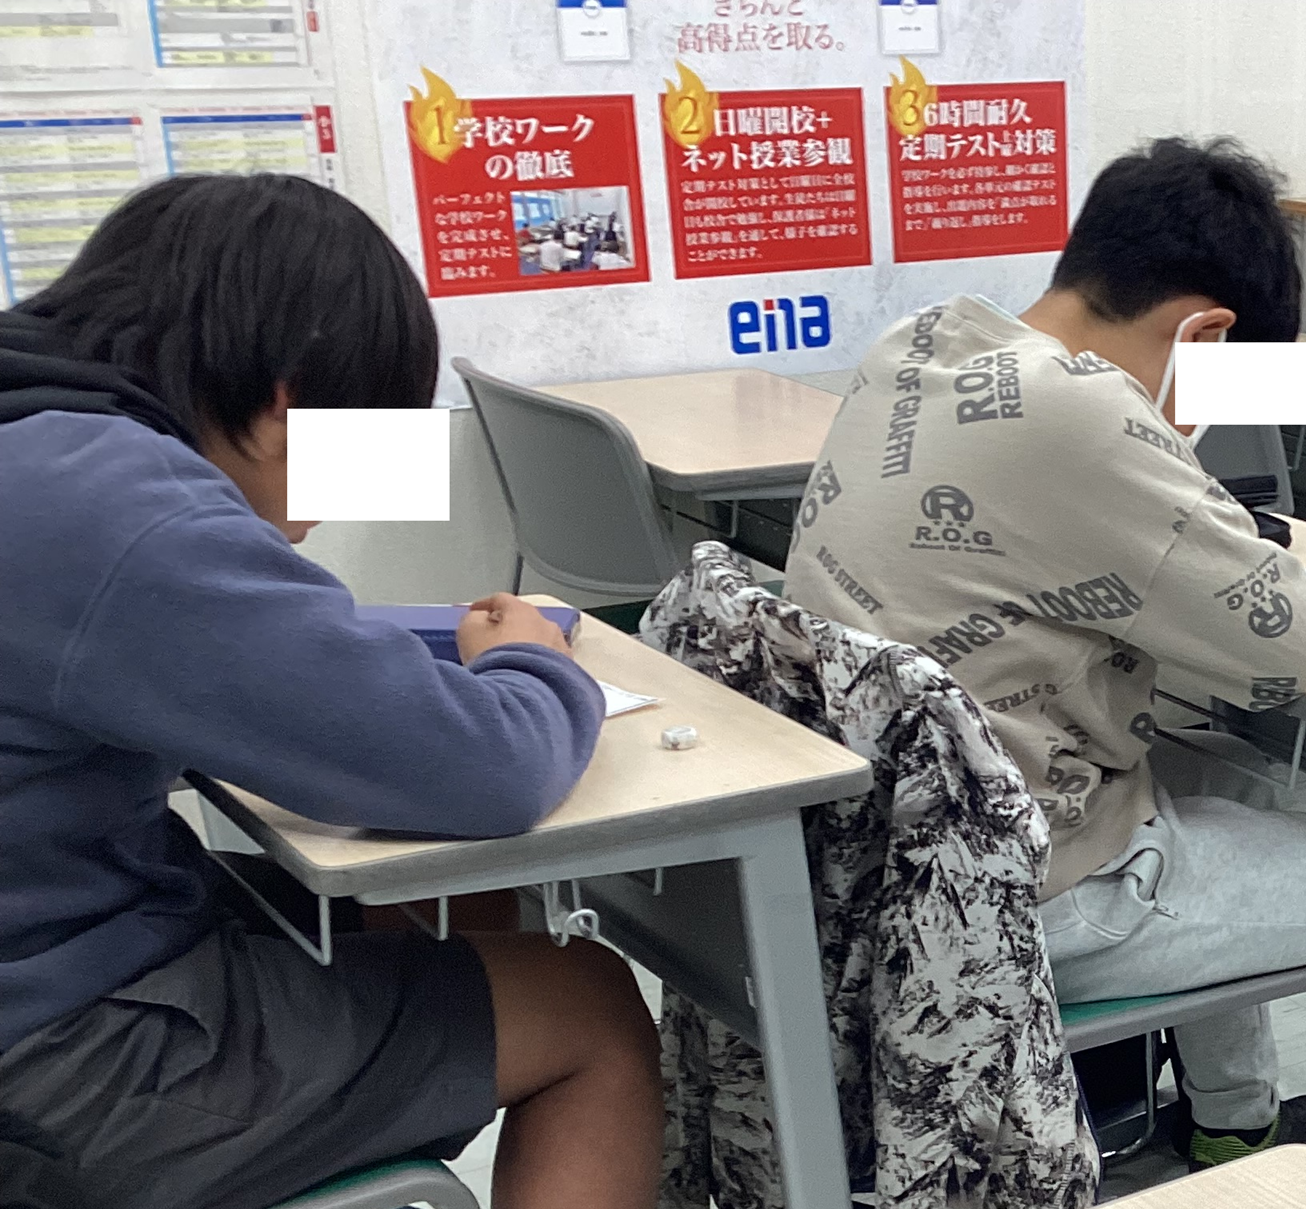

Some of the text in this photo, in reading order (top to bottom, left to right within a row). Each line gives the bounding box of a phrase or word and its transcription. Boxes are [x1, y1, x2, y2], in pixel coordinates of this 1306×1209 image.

[676, 22, 846, 53] 高得点を取る。
[678, 96, 701, 135] 2
[902, 89, 919, 126] 3
[923, 97, 1033, 128] 6時間耐久
[453, 114, 595, 149] 学校ワーク
[484, 149, 575, 182] の徹底
[681, 137, 855, 173] ネット授業参観
[728, 295, 831, 355] ena
[996, 352, 1024, 419] REBOOT
[915, 526, 993, 546] R.O.G
